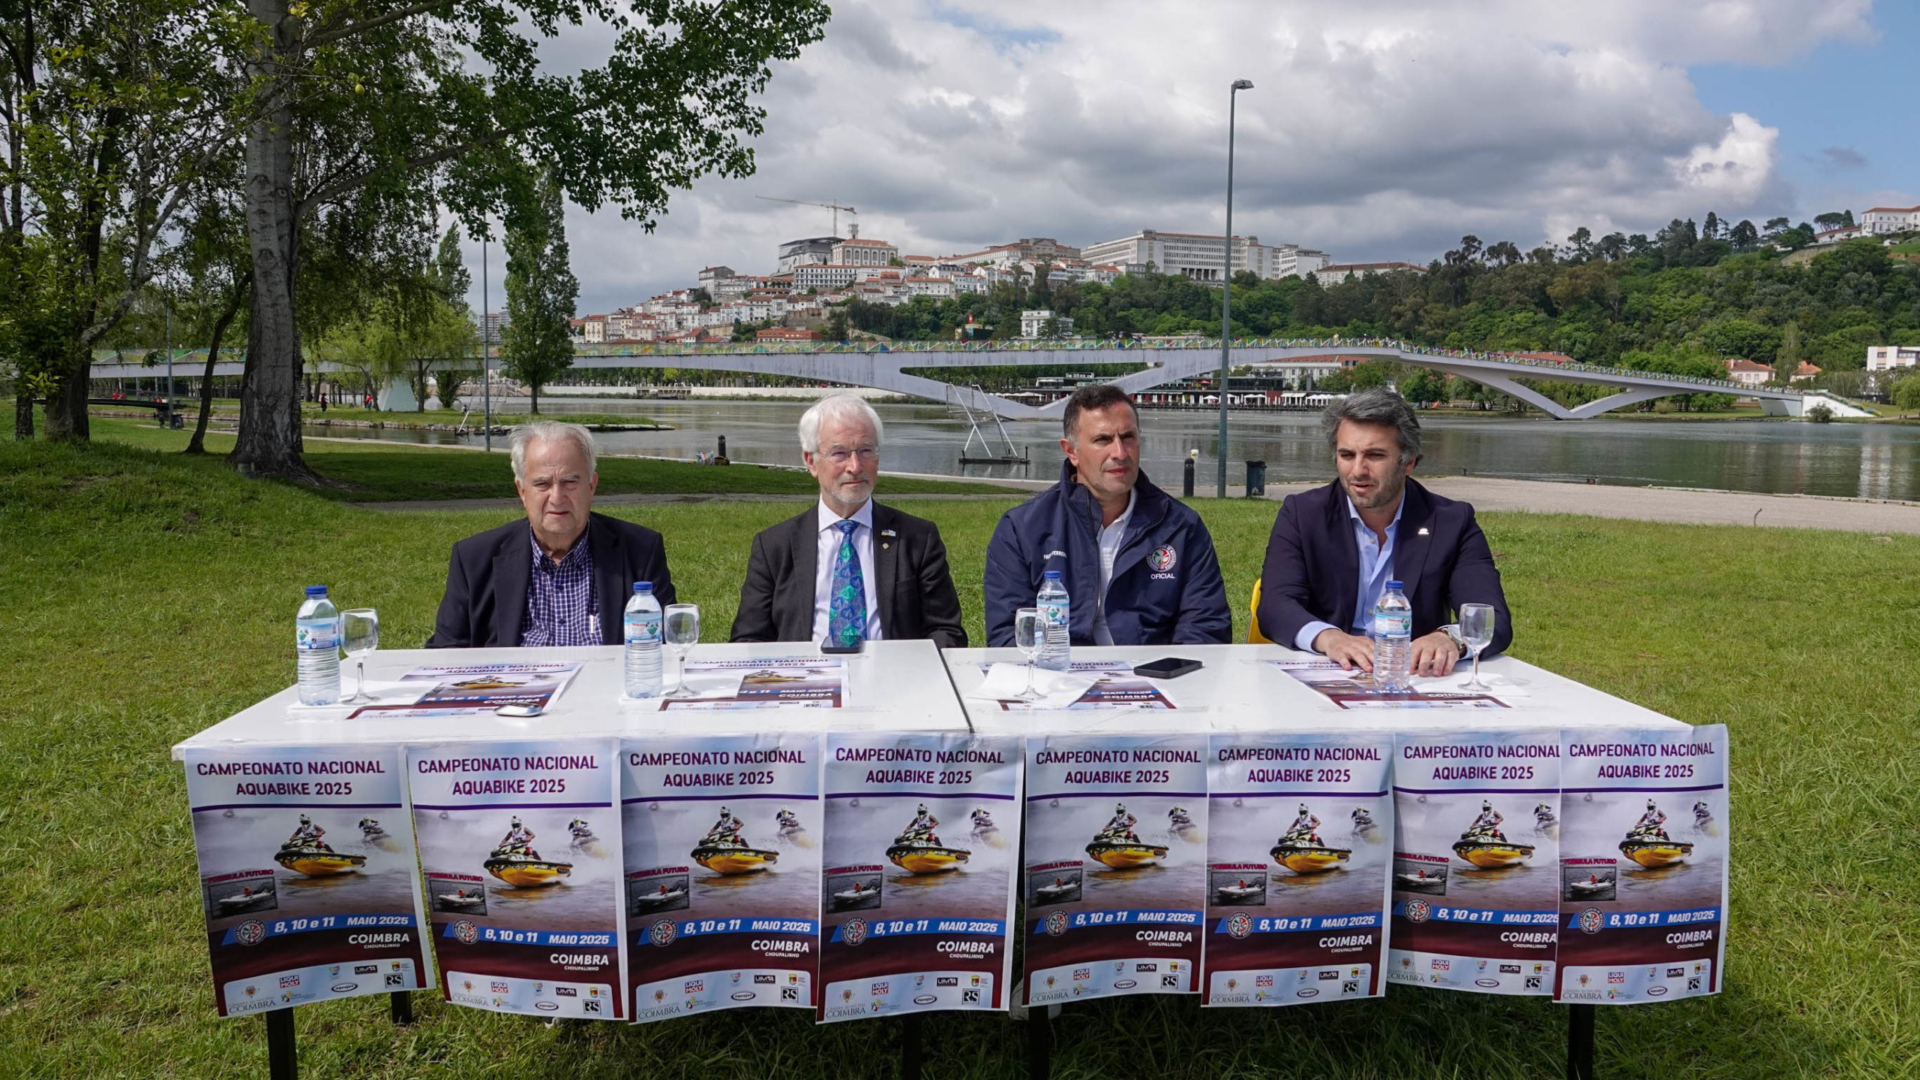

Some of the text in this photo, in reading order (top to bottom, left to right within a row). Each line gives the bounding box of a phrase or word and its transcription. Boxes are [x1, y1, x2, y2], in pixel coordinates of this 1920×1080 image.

[836, 748, 1004, 763] CAMPEONATO NACIONAL
[1219, 748, 1381, 761] CAMPEONATO NACIONAL
[1404, 745, 1560, 759] CAMPEONATO NACIONAL
[1570, 742, 1714, 757] CAMPEONATO NACIONAL
[630, 751, 805, 766] CAMPEONATO NACIONAL
[1036, 750, 1201, 764] CAMPEONATO NACIONAL
[197, 761, 385, 775] CAMPEONATO NACIONAL
[418, 756, 598, 773] CAMPEONATO NACIONAL
[1598, 764, 1693, 778] AQUABIKE 2025
[663, 771, 774, 787] AQUABIKE 2025
[866, 770, 972, 784] AQUABIKE 2025
[1065, 770, 1169, 784] AQUABIKE 2025
[1248, 769, 1350, 783] AQUABIKE 2025
[1433, 766, 1533, 780] AQUABIKE 2025
[236, 782, 352, 795] AQUABIKE 2025
[453, 779, 565, 795] AQUABIKE 2025
[1076, 913, 1086, 925] 8,
[1090, 912, 1104, 923] 10
[1116, 912, 1127, 921] 11
[1137, 913, 1165, 921] MAIO
[1166, 913, 1195, 922] 2025
[1438, 908, 1558, 923] 8, 10 e 11 MAIO 2025
[1610, 915, 1621, 926] 8,
[1624, 914, 1638, 924] 10
[1649, 913, 1659, 923] 11
[1668, 914, 1691, 923] MAIO
[1692, 911, 1715, 920] 2025
[274, 917, 408, 933] 8, 10 e 11 MAIO 2025
[684, 920, 811, 935] 8, 10 e 11 MAIO 2025
[874, 923, 885, 935] 8,
[889, 922, 901, 932] 10
[917, 920, 928, 931] 11
[938, 921, 967, 931] MAIO
[968, 922, 998, 932] 2025
[1259, 916, 1375, 931] 8, 10 e 11 MAIO 2025
[349, 933, 409, 944] COIMBRA
[485, 929, 496, 940] 8,
[499, 931, 513, 940] 10
[527, 932, 538, 942] 11
[549, 935, 577, 944] MAIO
[579, 935, 609, 944] 2025
[1136, 931, 1192, 942] COIMBRA
[1319, 935, 1372, 948] COIMBRA
[1501, 932, 1557, 942] COIMBRA
[1666, 930, 1712, 944] COIMBRA
[751, 940, 809, 952] COIMBRA
[937, 941, 994, 953] COIMBRA
[550, 954, 609, 965] COIMBRA
[1031, 991, 1068, 1003] COIMBRA
[229, 1000, 276, 1014] COIMBRA
[638, 1006, 681, 1019] COIMBRA
[826, 1007, 865, 1018] COIMBRA
